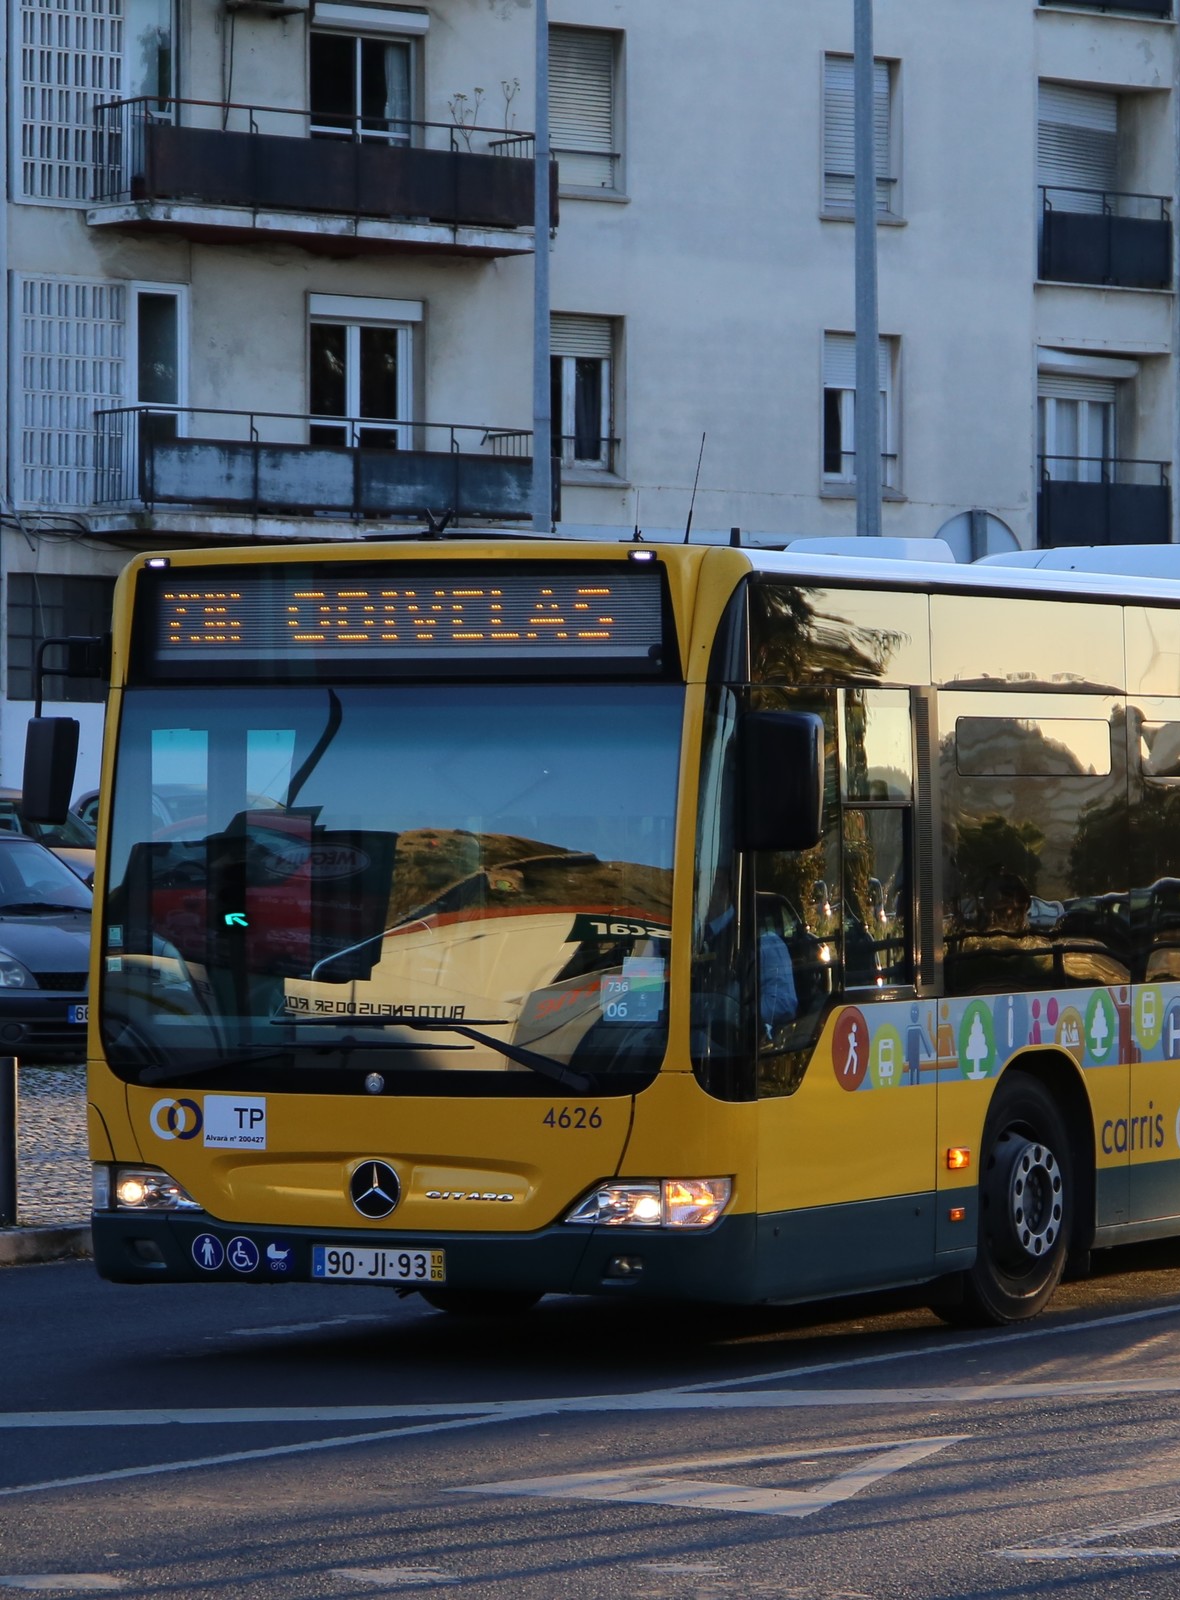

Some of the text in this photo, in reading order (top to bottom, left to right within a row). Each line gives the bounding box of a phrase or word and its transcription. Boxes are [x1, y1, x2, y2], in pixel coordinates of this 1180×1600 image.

[287, 588, 614, 640] ODIVELAS
[608, 981, 629, 993] 736
[606, 1002, 628, 1017] 06
[234, 1107, 264, 1129] TP
[542, 1106, 603, 1129] 4626
[1101, 1100, 1165, 1155] carris
[238, 1135, 264, 1143] 200427
[425, 1189, 515, 1202] CITARO
[431, 1254, 443, 1264] 10
[431, 1269, 443, 1279] 06
